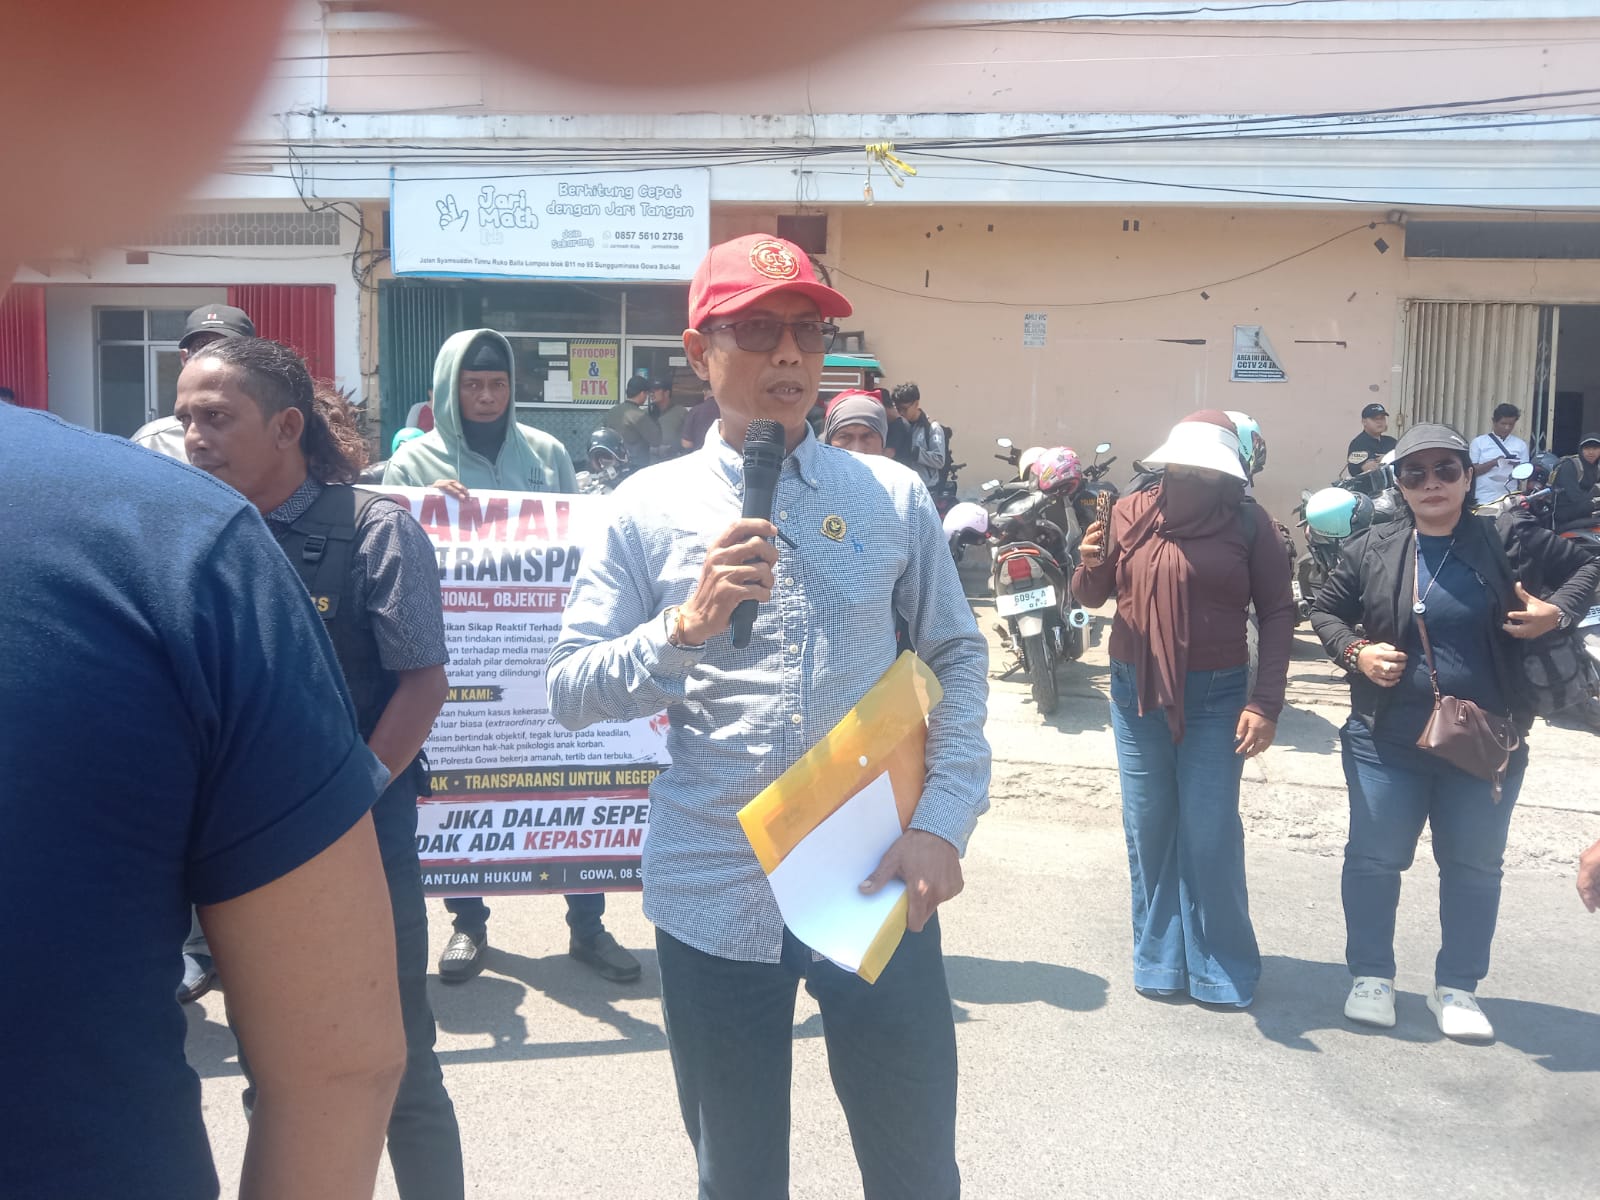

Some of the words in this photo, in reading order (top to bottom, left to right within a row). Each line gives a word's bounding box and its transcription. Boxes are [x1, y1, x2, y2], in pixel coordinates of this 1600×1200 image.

[478, 185, 526, 209] Jari
[558, 182, 634, 199] Berhitung
[638, 184, 682, 200] Cepat
[546, 200, 601, 217] dengan
[605, 201, 635, 216] Jari
[640, 202, 694, 219] Tangan
[478, 206, 539, 229] Math
[615, 231, 636, 240] 0857
[639, 232, 660, 240] 5610
[662, 232, 684, 241] 2736
[572, 348, 616, 358] FOTOCOPY
[589, 361, 599, 376] &
[581, 380, 608, 396] ATK
[440, 591, 489, 608] IONAL,
[493, 592, 557, 607] OBJEKTIF
[468, 622, 493, 632] Sikap
[496, 623, 527, 631] Reaktif
[465, 634, 501, 643] tindakan
[461, 645, 500, 656] terhadap
[502, 645, 528, 653] media
[453, 657, 481, 665] adalah
[483, 657, 502, 667] pilar
[476, 671, 496, 679] yang
[499, 668, 541, 678] dilindungi
[461, 688, 494, 700] KAMI:
[457, 708, 486, 717] hukum
[488, 707, 511, 716] kasus
[441, 719, 457, 728] luar
[460, 718, 483, 728] biasa
[485, 717, 546, 729] (extraordinary
[454, 731, 494, 742] bertindak
[496, 731, 527, 743] objektif,
[529, 729, 551, 740] tegak
[553, 728, 574, 738] lurus
[575, 728, 595, 739] pada
[596, 727, 631, 738] keadilan,
[431, 743, 481, 753] memulihkan
[482, 741, 515, 751] hak-hak
[516, 740, 555, 751] psikologis
[556, 739, 575, 749] anak
[577, 739, 605, 748] korban.
[440, 756, 473, 765] Polresta
[475, 755, 498, 764] Gowa
[500, 753, 528, 764] bekerja
[530, 752, 563, 761] amanah,
[565, 751, 586, 760] tertib
[587, 751, 602, 760] dan
[603, 750, 634, 759] terbuka.
[464, 771, 564, 790] TRANSPARANSI
[568, 770, 611, 786] UNTUK
[438, 809, 493, 830] JIKA
[502, 806, 586, 828] DALAM
[591, 804, 651, 825] SEPE
[468, 832, 515, 852] ADA
[523, 828, 643, 850] KEPASTIAN
[421, 872, 479, 886] ANTUAN
[484, 871, 533, 884] HUKUM
[580, 868, 617, 880] GOWA,
[620, 868, 633, 879] 08
